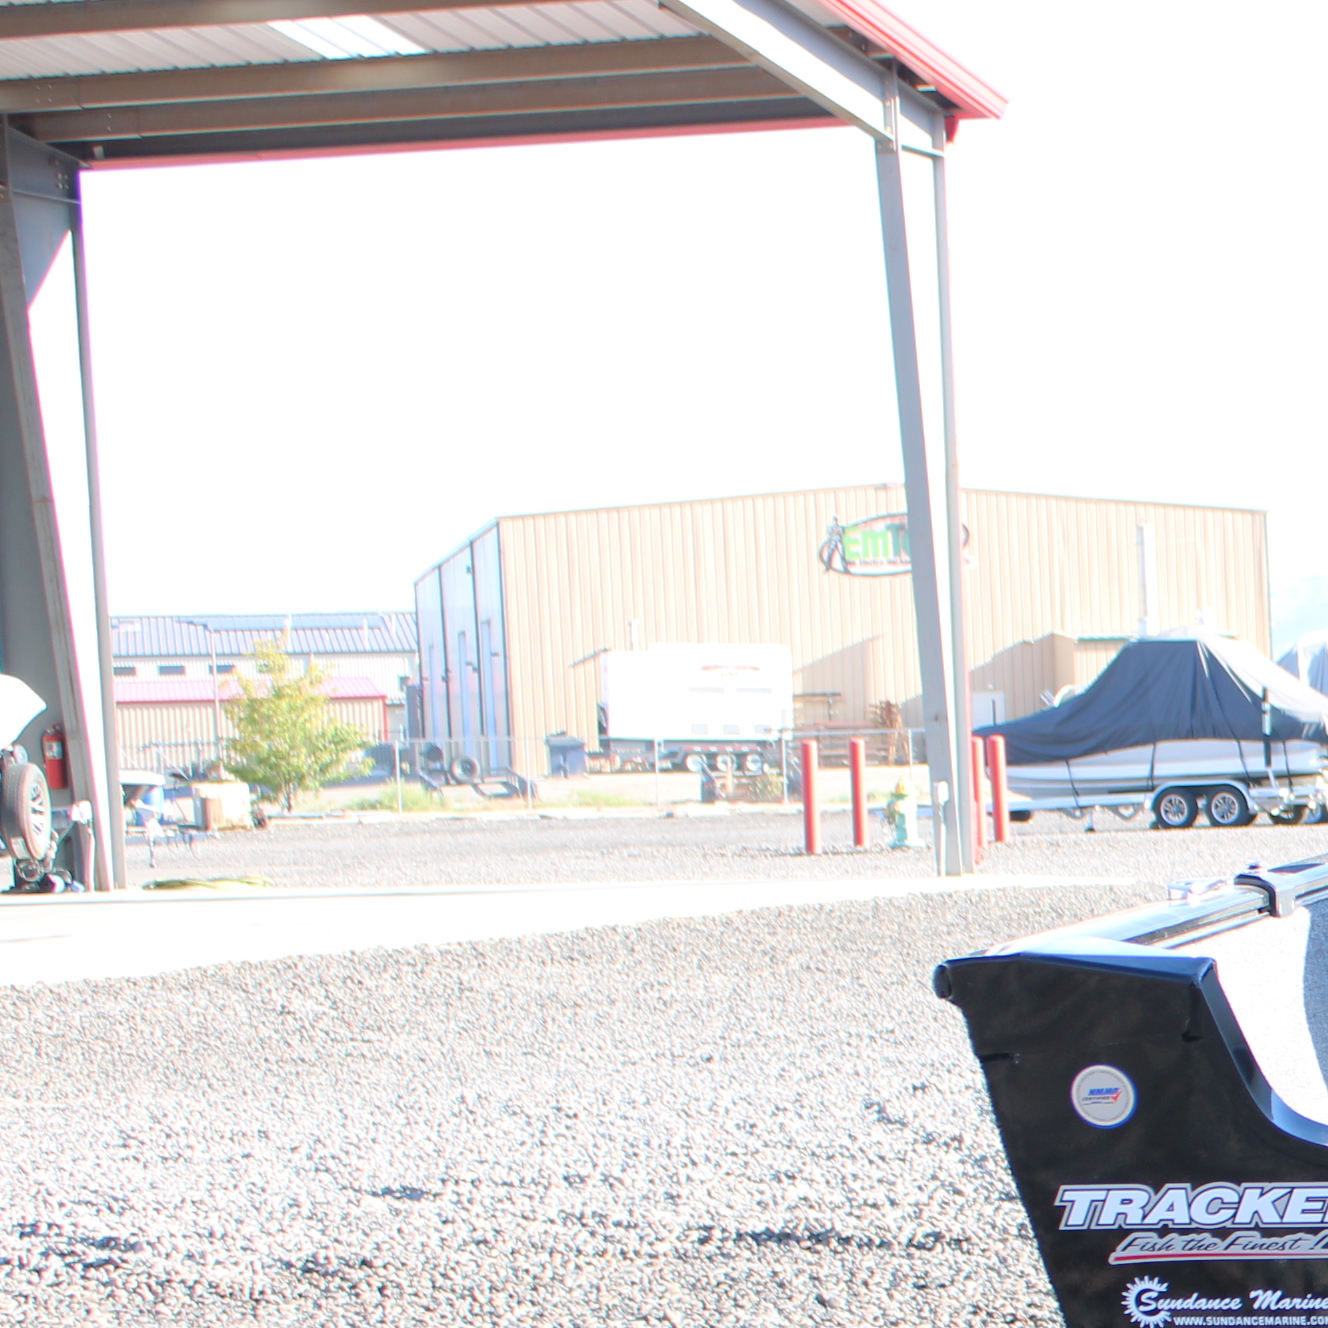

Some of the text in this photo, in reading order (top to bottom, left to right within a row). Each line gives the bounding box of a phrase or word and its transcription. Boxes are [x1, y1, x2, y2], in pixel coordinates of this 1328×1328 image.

[1121, 1236, 1176, 1252] Fish
[1181, 1236, 1221, 1252] the
[1138, 1291, 1243, 1312] Sundance
